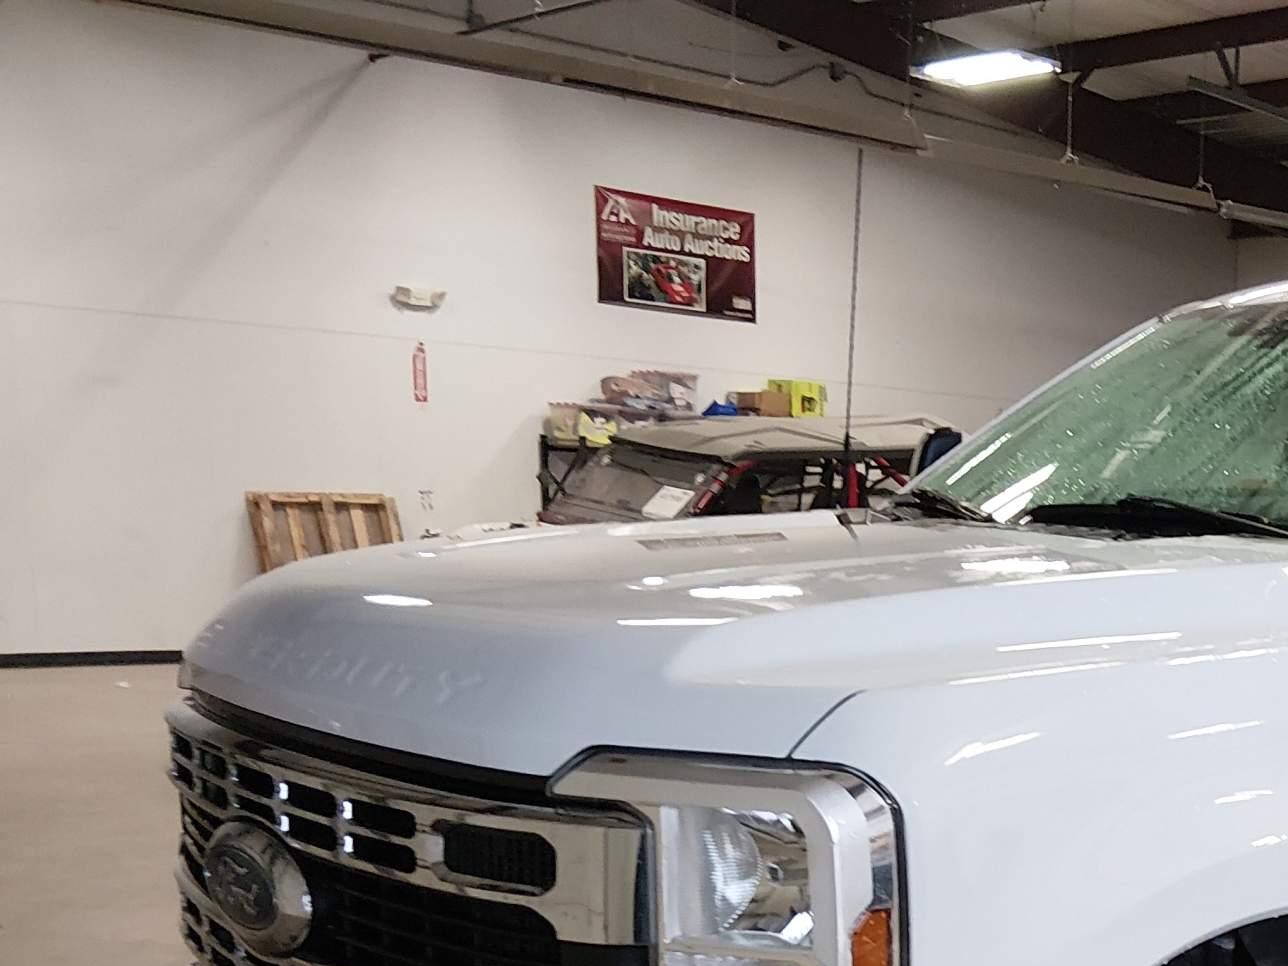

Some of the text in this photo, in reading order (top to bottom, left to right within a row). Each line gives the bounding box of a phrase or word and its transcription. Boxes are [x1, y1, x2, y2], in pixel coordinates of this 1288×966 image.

[651, 203, 741, 240] Insurance
[642, 226, 681, 251] Auto
[683, 233, 751, 262] Auctions
